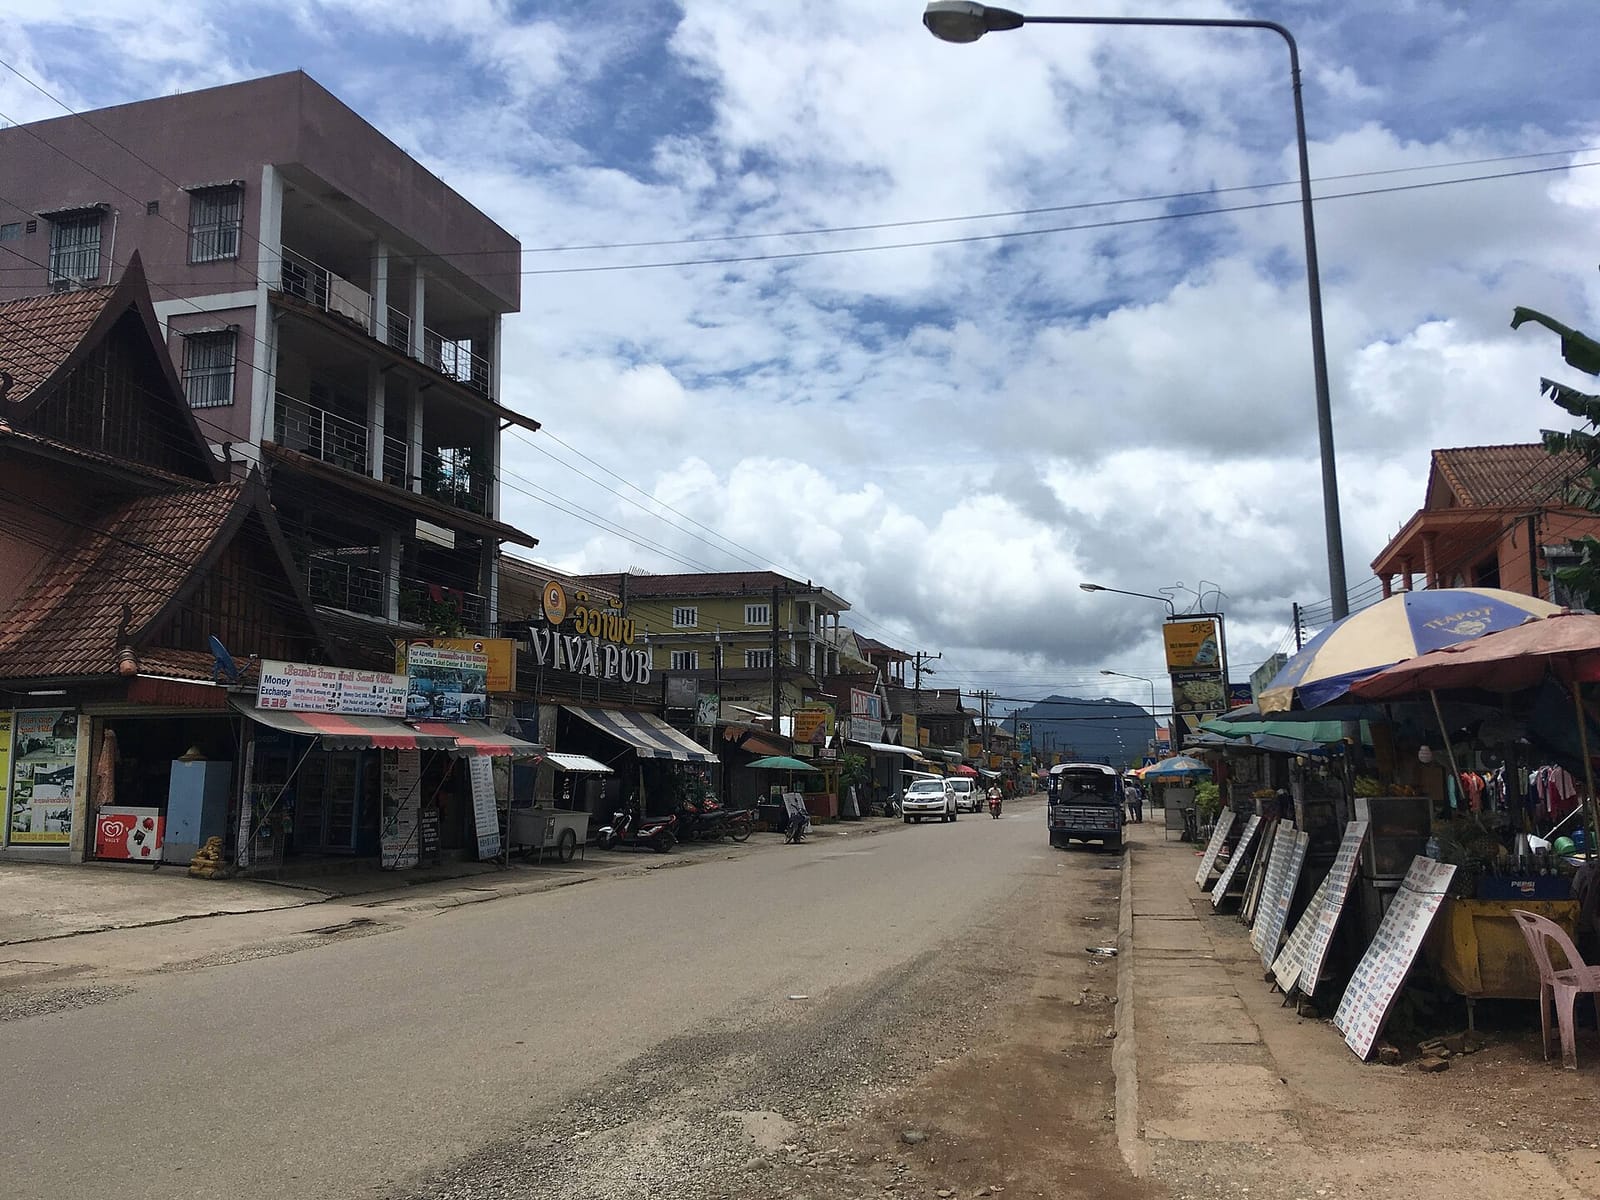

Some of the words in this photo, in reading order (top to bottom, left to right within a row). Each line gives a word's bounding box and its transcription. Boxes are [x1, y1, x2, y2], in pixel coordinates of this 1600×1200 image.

[1422, 607, 1493, 629] TEAPOT
[529, 626, 597, 677] VIVA
[602, 644, 651, 685] PUB
[264, 674, 292, 687] Money
[260, 685, 292, 698] Exchange
